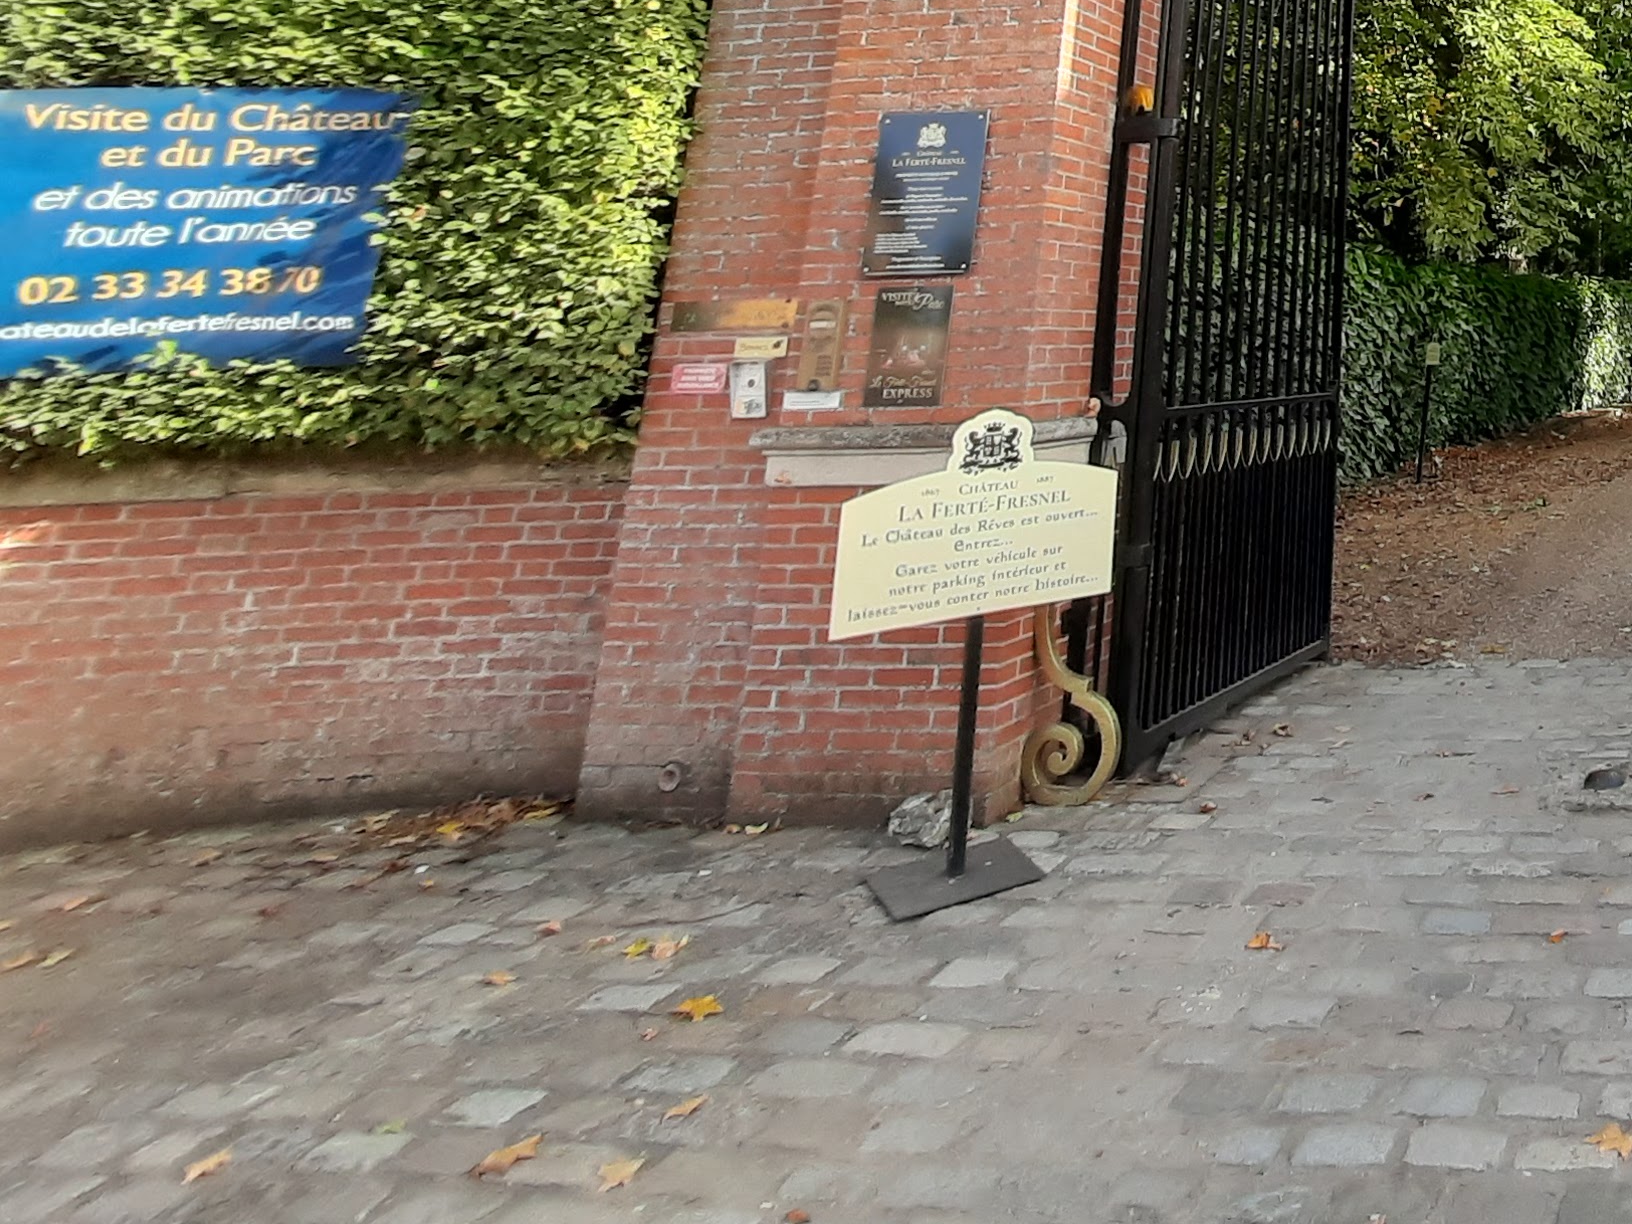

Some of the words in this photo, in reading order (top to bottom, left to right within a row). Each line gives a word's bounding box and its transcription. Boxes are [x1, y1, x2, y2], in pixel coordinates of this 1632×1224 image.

[25, 103, 149, 131] Visite
[163, 103, 216, 131] du
[231, 103, 397, 132] Château
[101, 146, 146, 167] et
[158, 137, 212, 167] du
[223, 137, 318, 167] Parc
[34, 184, 82, 210] et
[84, 181, 159, 210] des
[167, 182, 358, 210] animations
[63, 220, 172, 248] toute
[178, 215, 317, 244] l'année
[19, 276, 79, 306] 02
[92, 272, 147, 300] 33
[156, 269, 209, 299] 34
[219, 267, 273, 296] 38
[276, 267, 322, 293] 70
[882, 387, 934, 399] EXPRESS
[958, 479, 1020, 496] CHÂTEAU
[898, 505, 924, 522] LA
[931, 489, 1072, 520] FERTÉ-FRESNEL
[861, 534, 879, 548] Le
[885, 527, 944, 544] Château
[949, 522, 971, 536] des
[1020, 514, 1040, 526] est
[1045, 508, 1099, 523] ouvert...
[894, 562, 939, 578] Garez
[944, 557, 980, 572] votre
[986, 546, 1038, 566] véhicule
[1043, 544, 1064, 556] sur
[889, 584, 926, 598] notre
[932, 570, 986, 595] parking
[991, 564, 1050, 582] intérieur
[1054, 560, 1068, 572] et
[847, 598, 942, 623] laissez-vous
[946, 589, 990, 605] conter
[994, 583, 1031, 597] notre
[1035, 573, 1099, 592] histoire...
